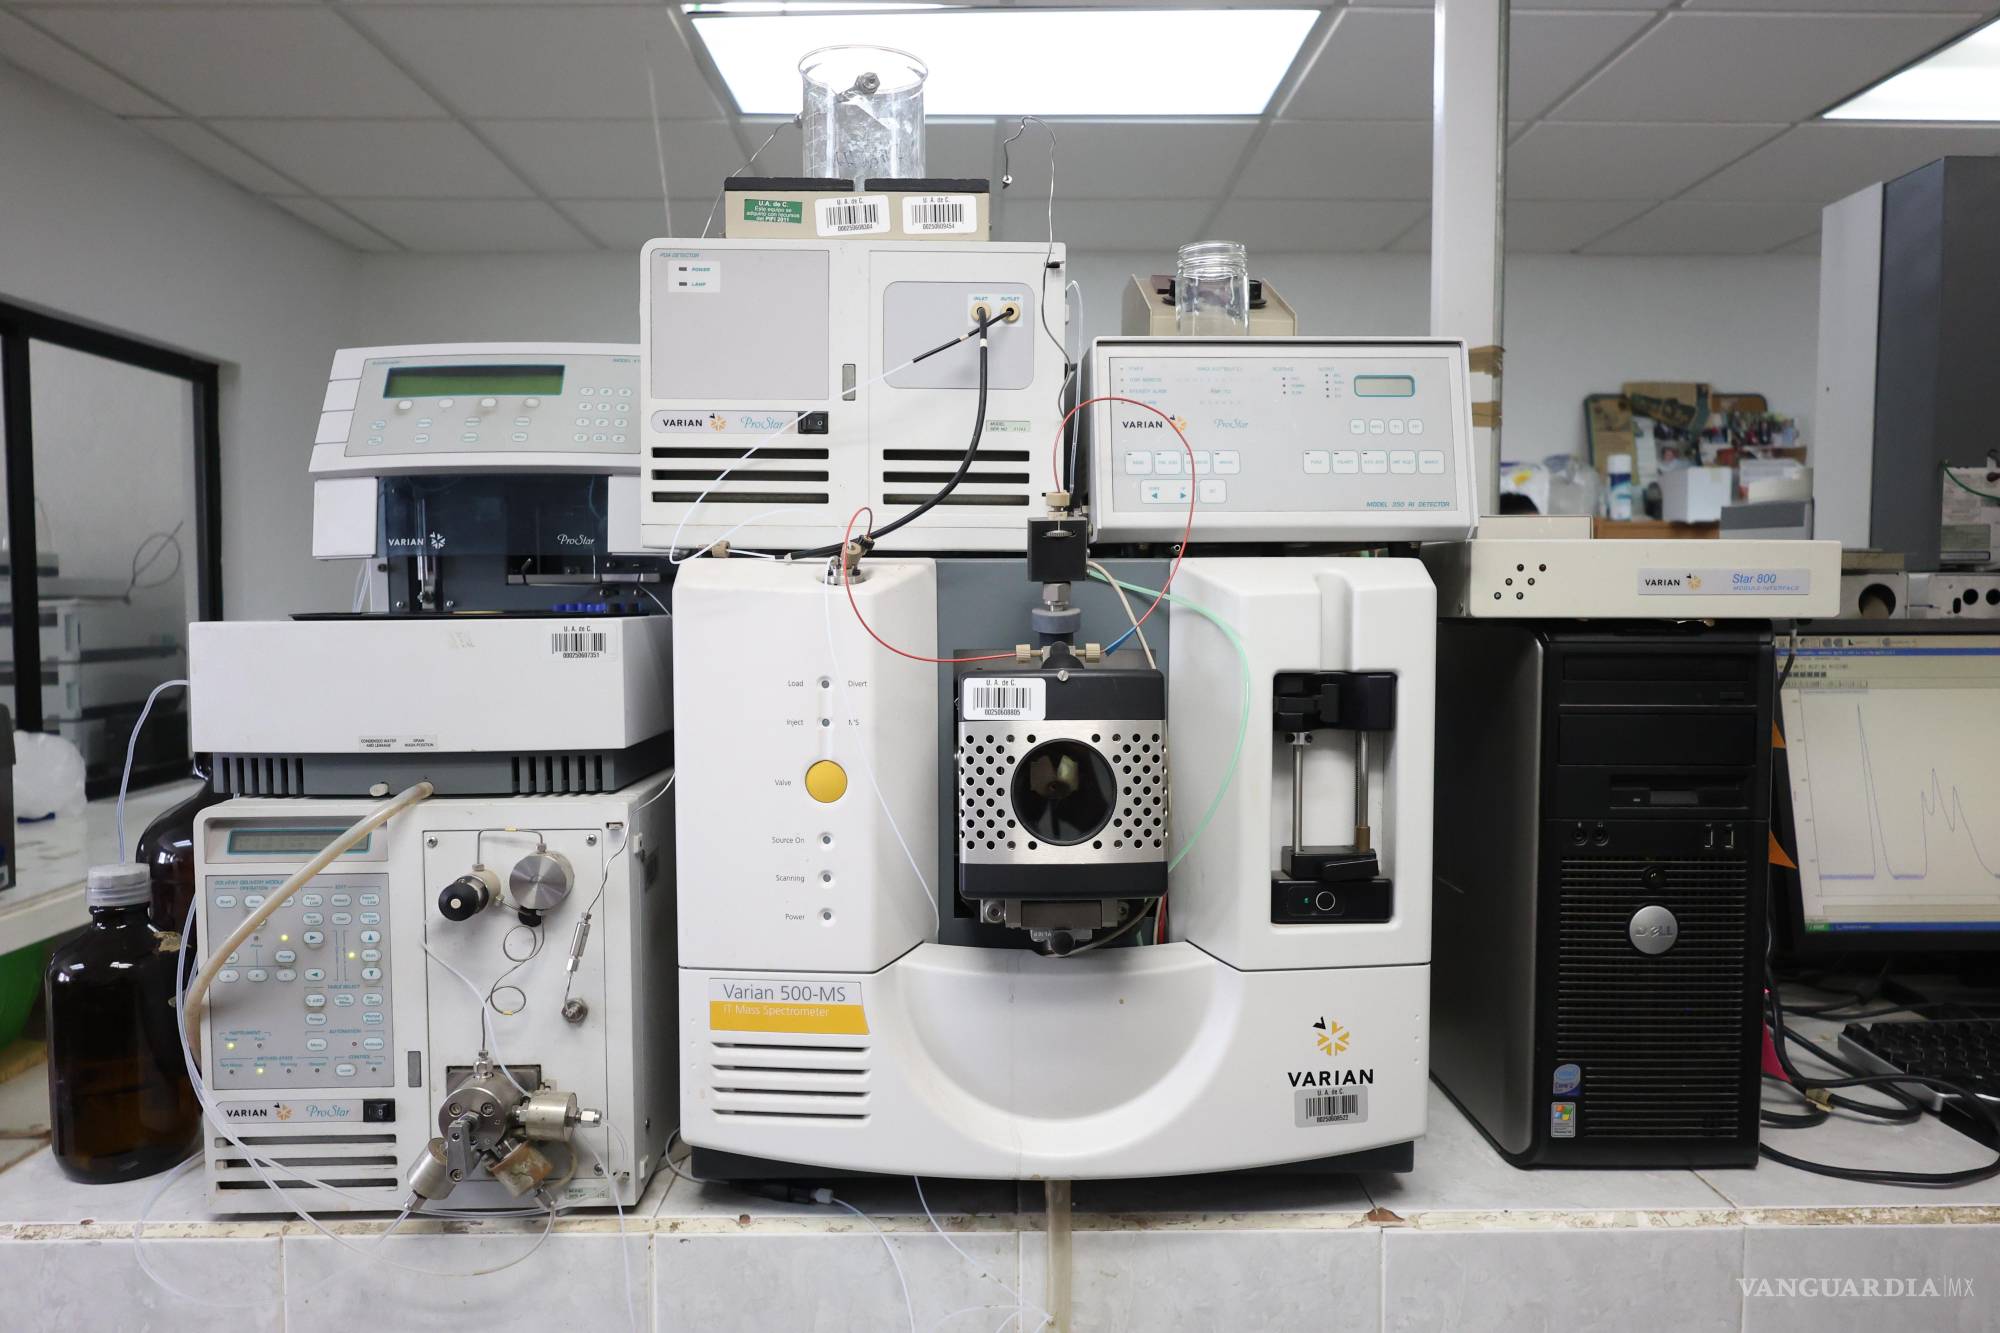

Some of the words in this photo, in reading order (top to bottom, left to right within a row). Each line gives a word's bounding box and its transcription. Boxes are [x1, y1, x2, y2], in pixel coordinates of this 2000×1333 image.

[663, 419, 703, 427] VARIAN
[741, 416, 784, 430] ProStar
[1122, 421, 1164, 429] VARIAN
[1214, 418, 1248, 430] ProStar
[388, 538, 424, 547] VARIAN
[557, 533, 595, 547] ProStar
[1645, 578, 1680, 586] VARIAN
[1732, 573, 1753, 584] Star
[1756, 573, 1777, 584] 800
[786, 719, 804, 727] Inject
[774, 778, 792, 786] Valve
[771, 836, 793, 844] Source
[795, 836, 805, 844] On
[775, 875, 805, 884] Scanning
[785, 913, 805, 921] Power
[1635, 926, 1673, 938] DELL
[723, 984, 774, 1001] Varian
[781, 985, 846, 1002] 500-MS
[735, 1005, 760, 1015] Mass
[764, 1005, 829, 1017] Spectrometer
[1287, 1068, 1374, 1088] VARIAN
[226, 1109, 267, 1117] VARIAN
[305, 1104, 350, 1118] ProStar
